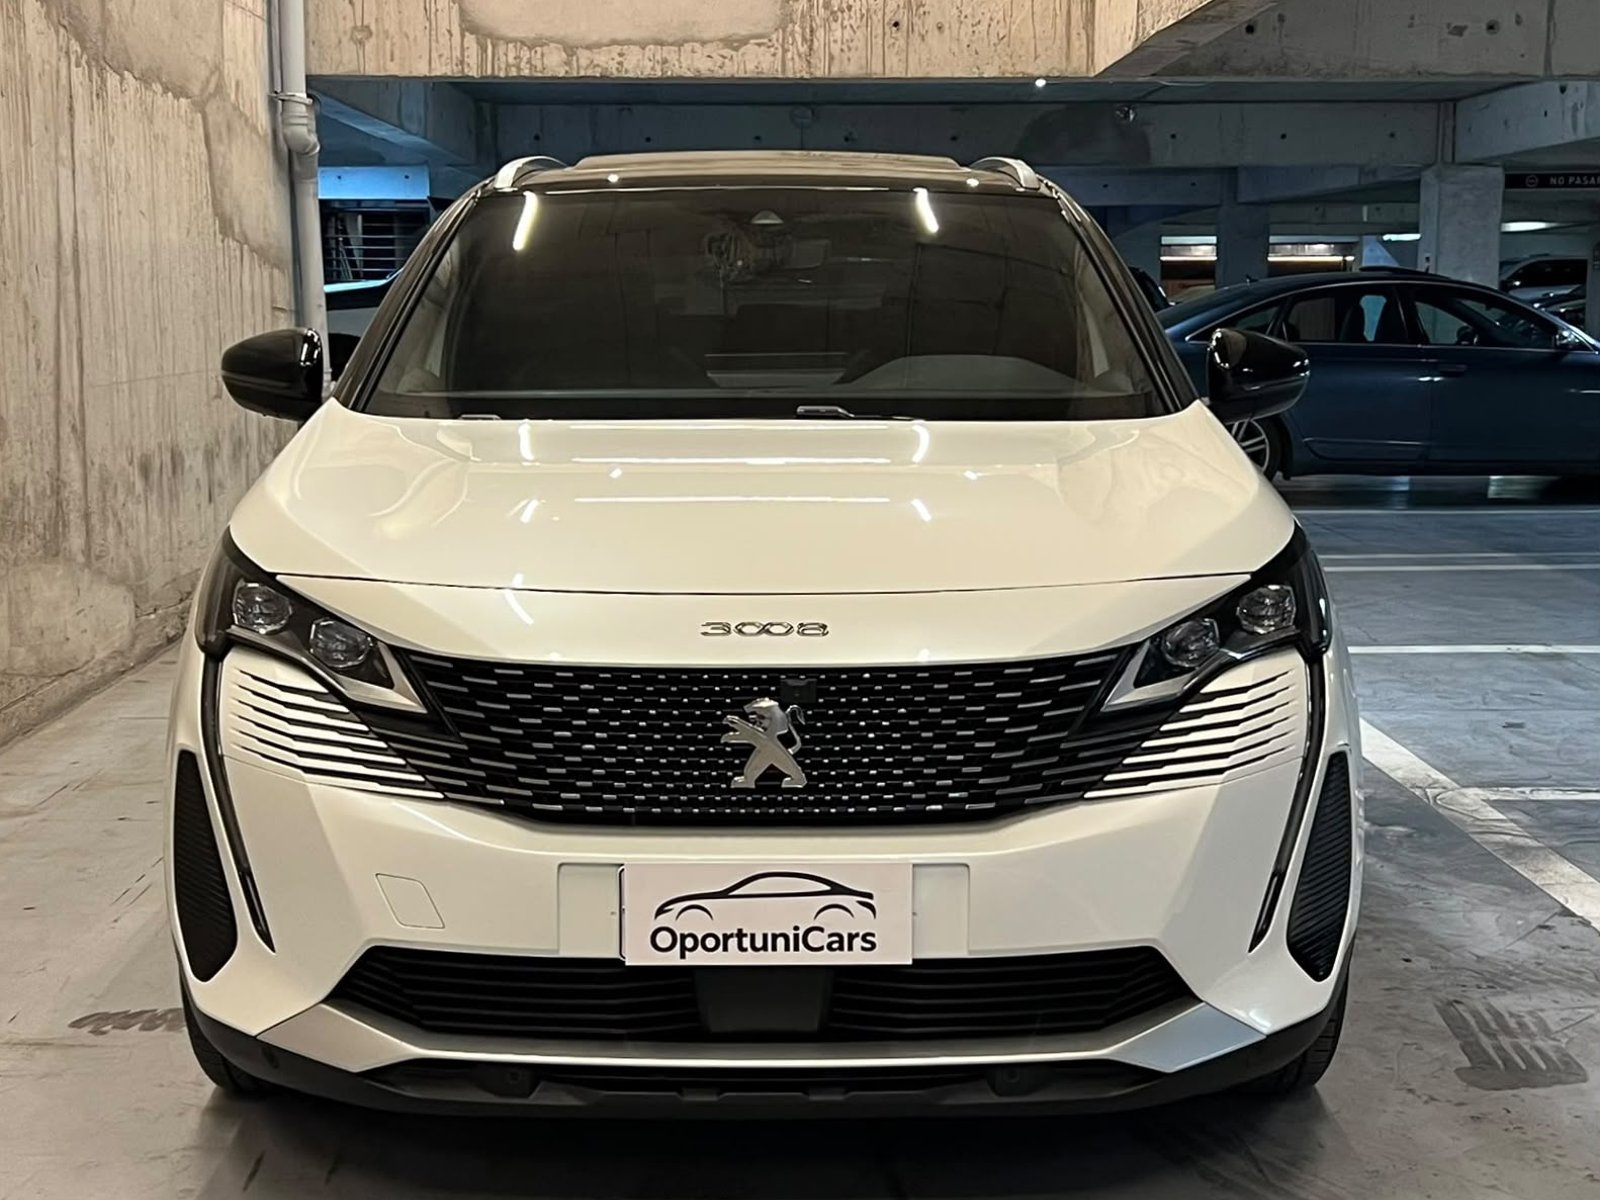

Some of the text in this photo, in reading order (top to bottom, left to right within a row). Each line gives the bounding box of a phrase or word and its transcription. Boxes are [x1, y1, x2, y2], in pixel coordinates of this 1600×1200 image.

[1550, 175, 1565, 185] NO
[700, 621, 829, 637] 3008
[650, 925, 877, 959] OportuniCars
